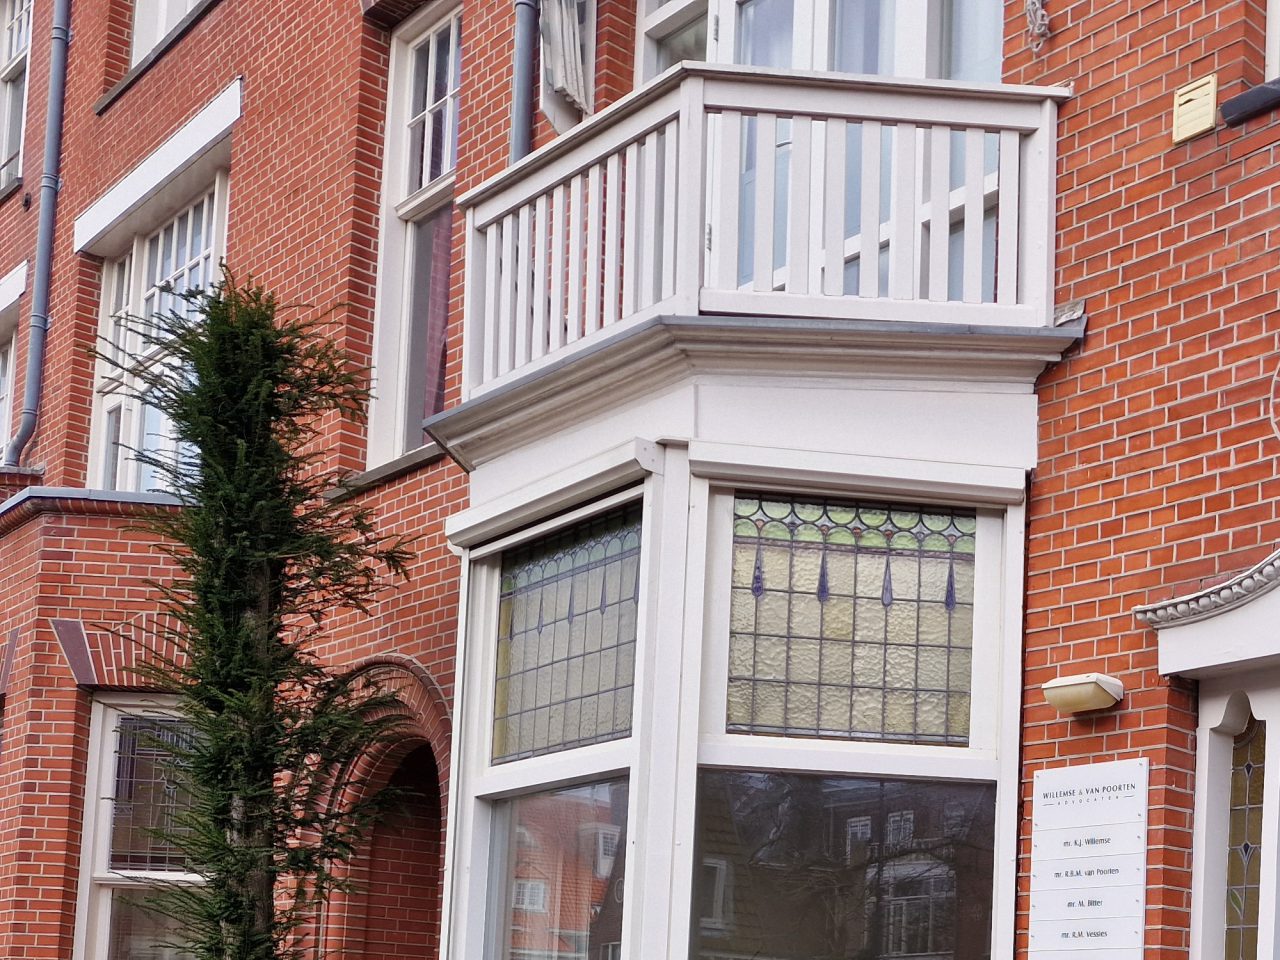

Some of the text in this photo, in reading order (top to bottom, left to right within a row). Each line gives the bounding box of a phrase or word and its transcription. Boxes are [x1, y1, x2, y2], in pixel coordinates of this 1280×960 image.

[1042, 789, 1076, 799] WILLEMSE
[1085, 786, 1100, 795] VAN
[1102, 783, 1136, 793] POORTEN
[1057, 795, 1119, 806] ADVOCATEN
[1085, 837, 1111, 846] Willemse
[1096, 867, 1119, 876] Poorten
[1087, 899, 1103, 907] Bitter
